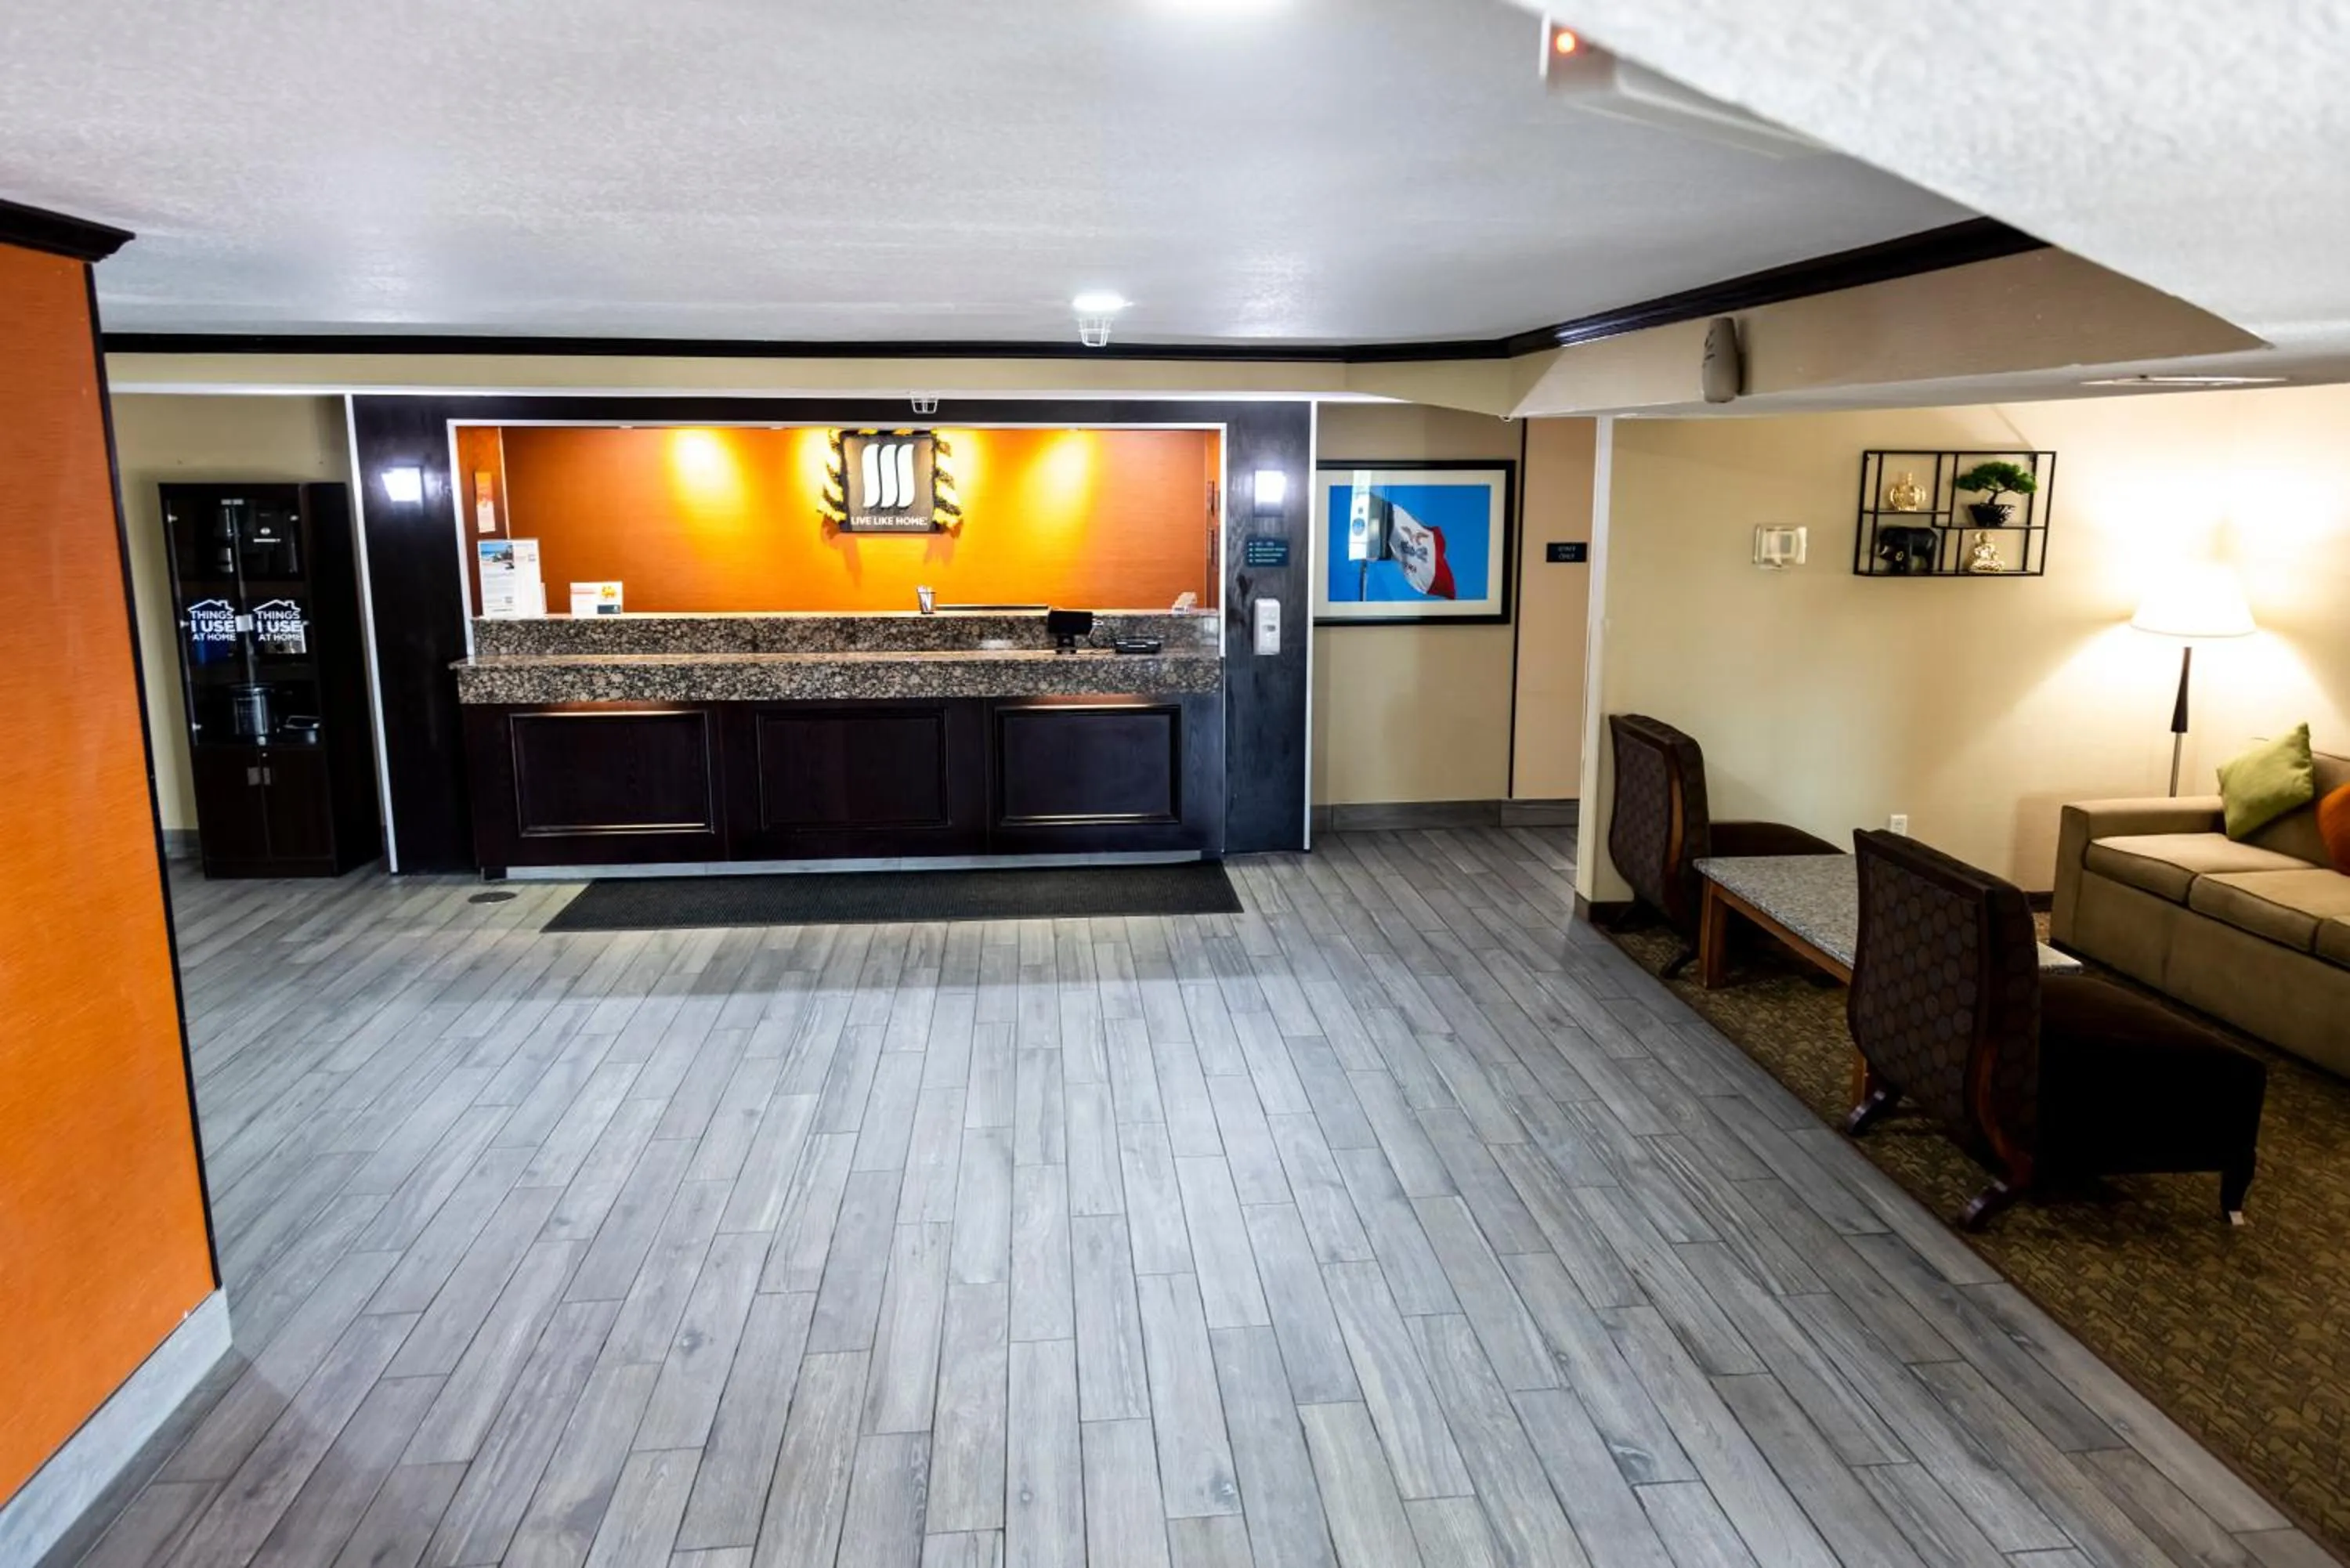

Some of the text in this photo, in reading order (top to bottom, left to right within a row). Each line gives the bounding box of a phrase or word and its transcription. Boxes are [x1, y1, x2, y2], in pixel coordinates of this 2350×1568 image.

[851, 516, 871, 526] LIVE
[873, 516, 893, 526] LIKE
[190, 611, 234, 620] THINGS
[256, 611, 301, 620] THINGS
[191, 620, 235, 632] I USE
[257, 620, 302, 633] I USE
[193, 633, 237, 641] AT HOME
